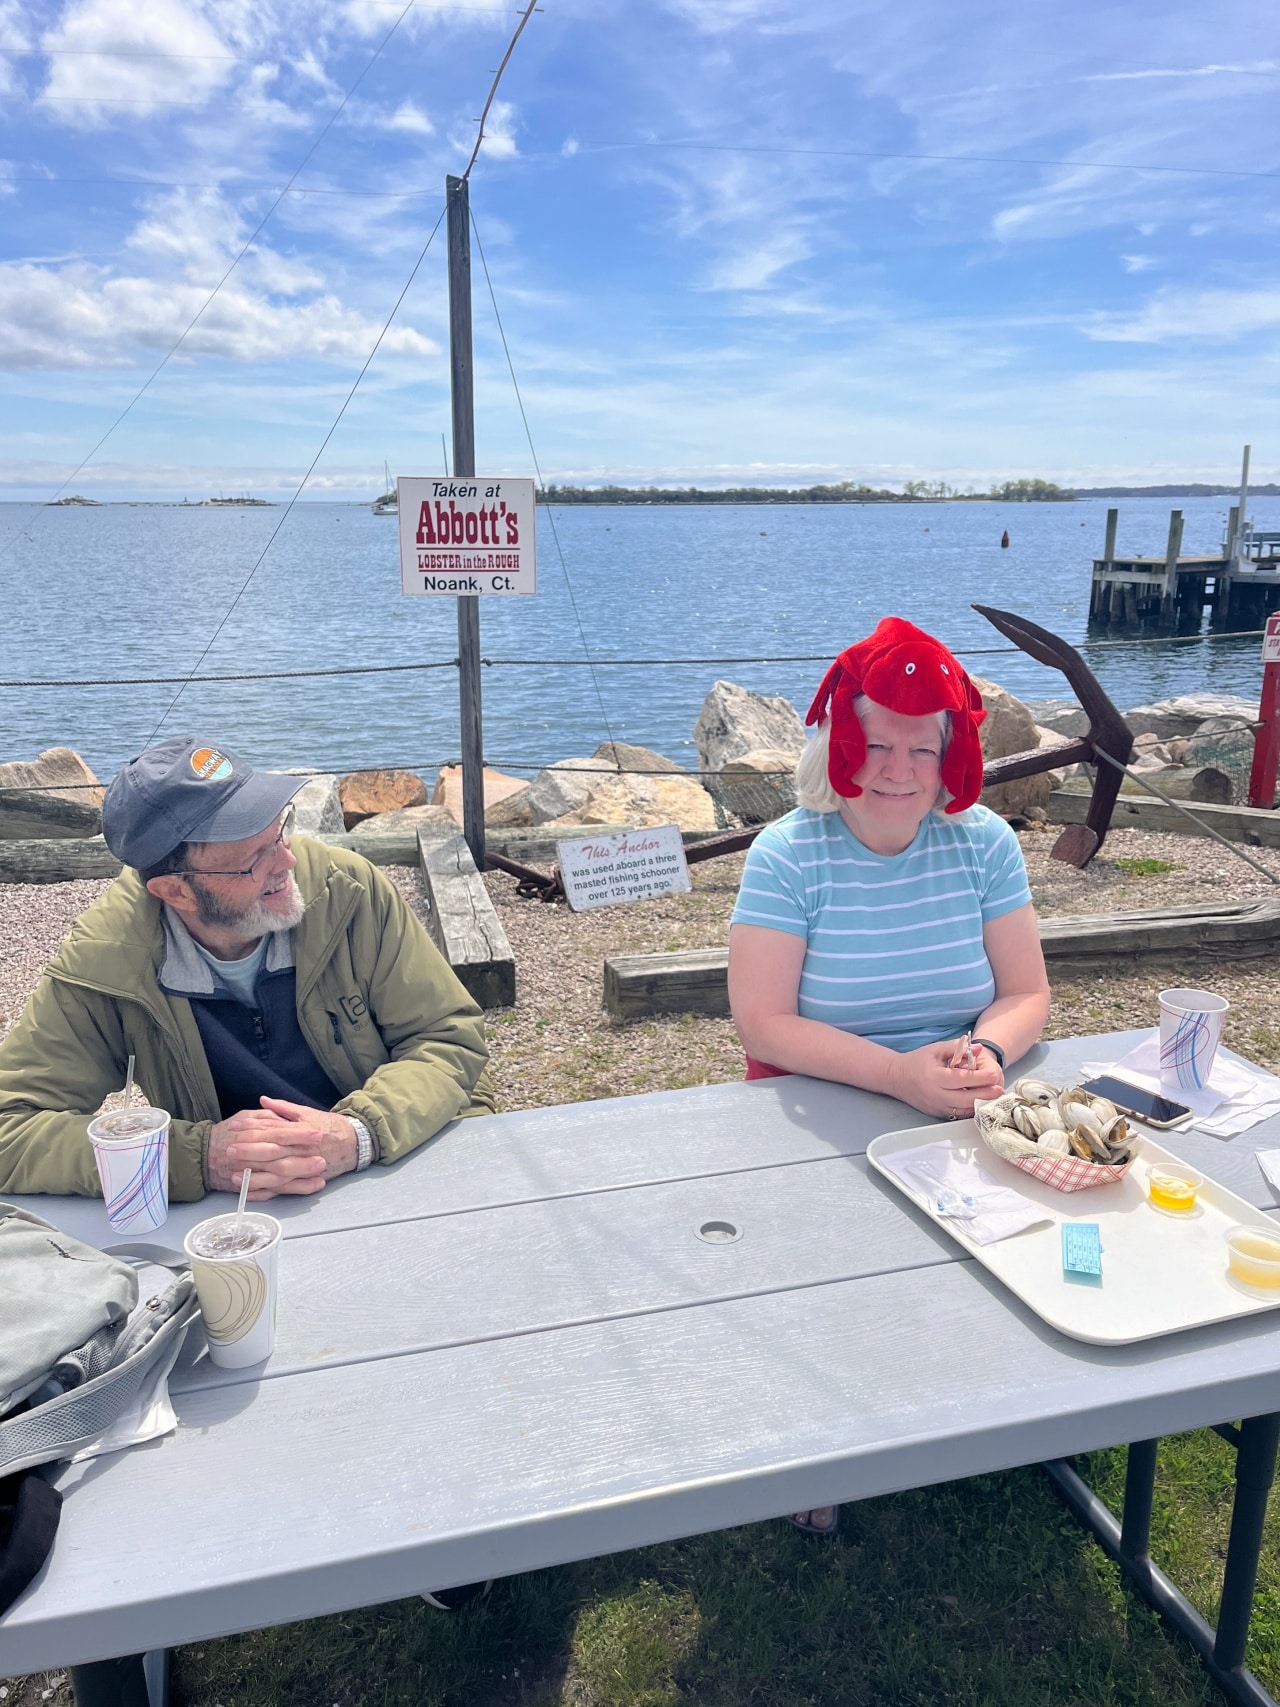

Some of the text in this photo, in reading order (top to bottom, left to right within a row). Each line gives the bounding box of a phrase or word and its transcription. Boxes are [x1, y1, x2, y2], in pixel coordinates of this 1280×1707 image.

[432, 482, 501, 497] Taken at
[416, 500, 519, 545] Abbott's
[418, 554, 520, 569] LOBSTER in the ROUGH
[424, 576, 515, 593] Noank, Ct.
[582, 838, 661, 860] This Anchor
[572, 854, 677, 877] was used aboard a three
[574, 866, 680, 890] masted fishing schooner
[588, 880, 672, 901] over 125 years ago.
